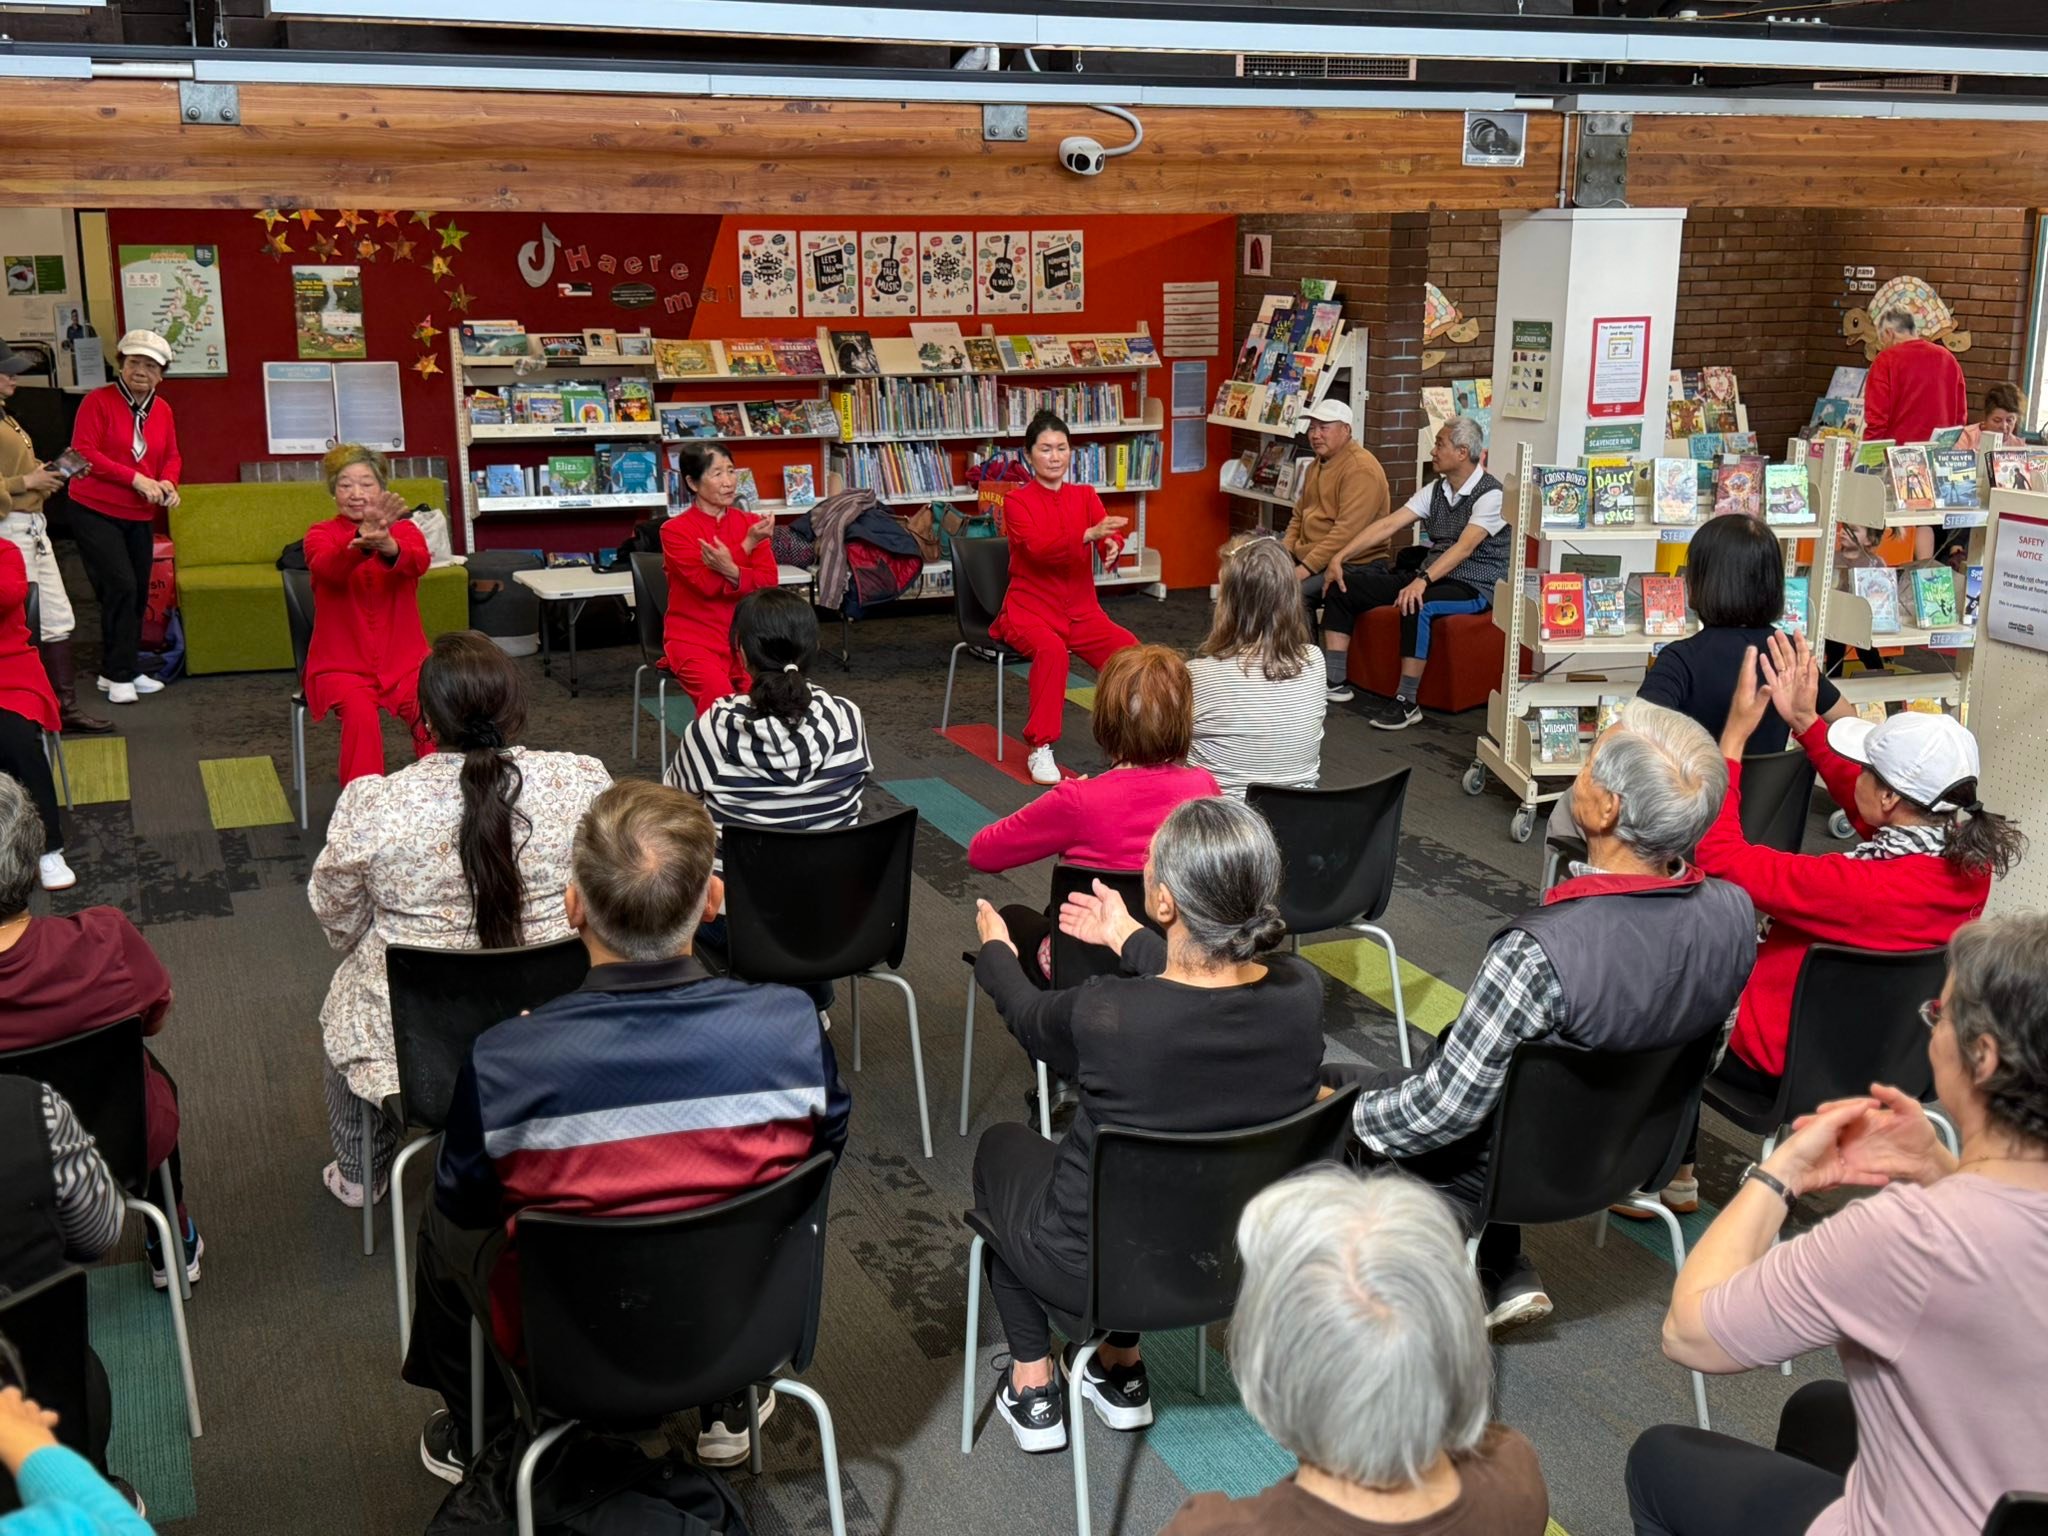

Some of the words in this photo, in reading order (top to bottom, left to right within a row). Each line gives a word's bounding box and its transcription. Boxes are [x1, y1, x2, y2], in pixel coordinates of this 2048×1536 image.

[565, 245, 689, 280] Haere
[877, 280, 900, 291] MUSIC
[664, 285, 734, 314] mai
[1589, 438, 1619, 447] SCAVENGER
[1620, 437, 1633, 445] HUNT
[1544, 472, 1565, 485] CROSS
[1565, 472, 1587, 486] BONES
[1596, 470, 1633, 488] DAISY
[1605, 509, 1634, 524] SPACE
[1945, 516, 1966, 526] STEP
[1662, 531, 1684, 541] STEP
[2019, 536, 2045, 547] SAFETY
[2016, 550, 2043, 561] NOTICE
[2004, 571, 2019, 579] Please
[1931, 634, 1951, 644] STEP
[1543, 723, 1576, 733] WILDSMITH
